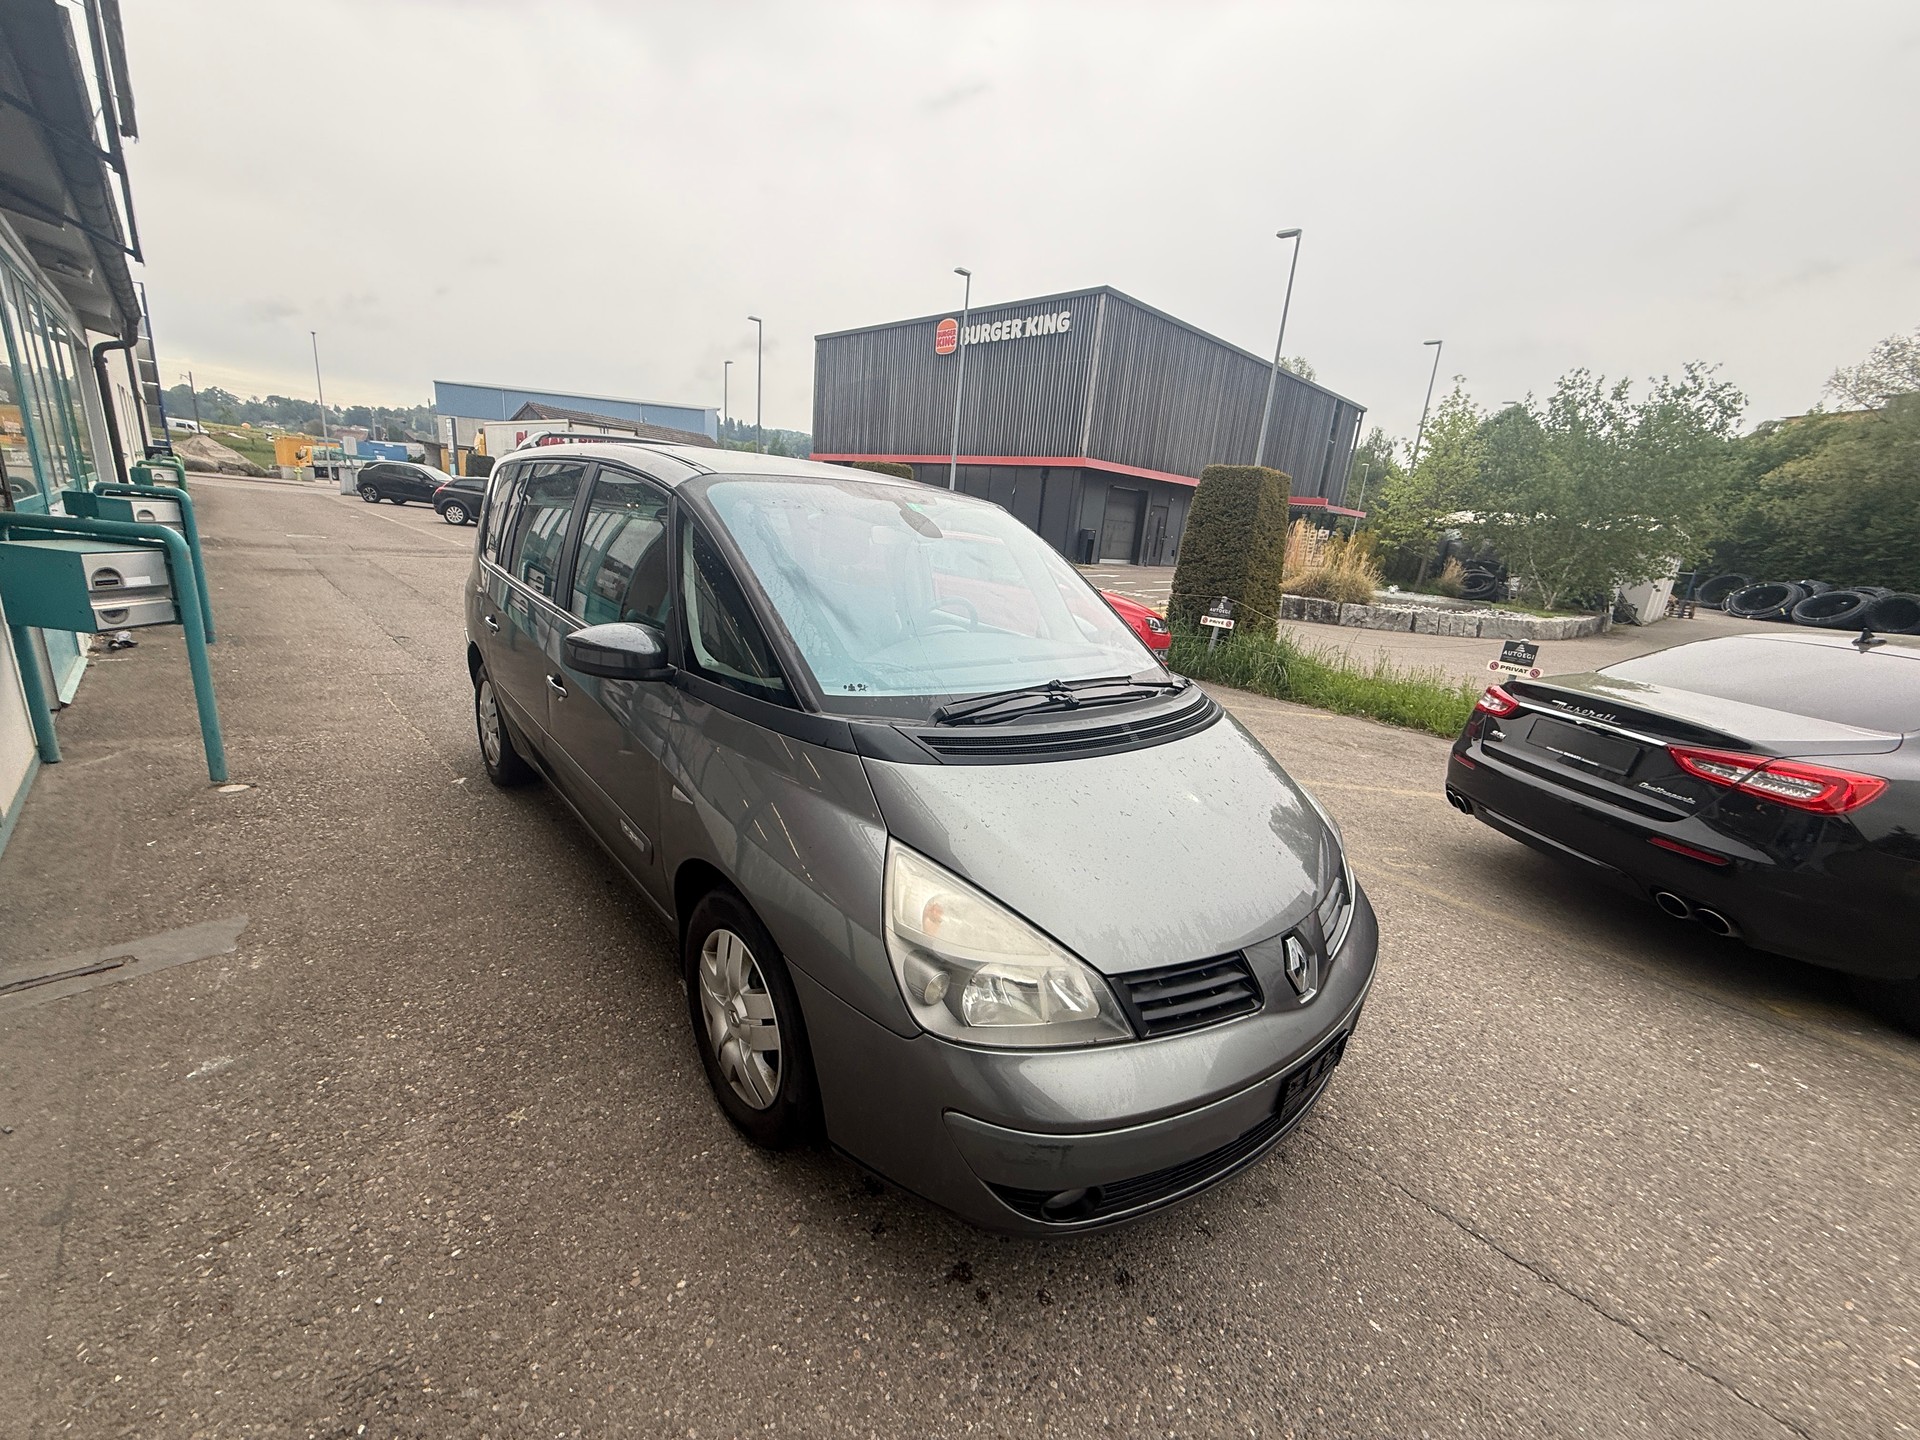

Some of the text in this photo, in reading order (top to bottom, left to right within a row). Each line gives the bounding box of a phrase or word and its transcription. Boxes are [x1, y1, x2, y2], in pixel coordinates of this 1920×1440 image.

[937, 329, 956, 337] BURGER
[960, 311, 1070, 345] BURGER KING
[937, 336, 956, 347] KING
[1502, 650, 1535, 660] AUTOEGI
[1500, 664, 1529, 674] PRIVAT
[1552, 699, 1621, 724] Maserati
